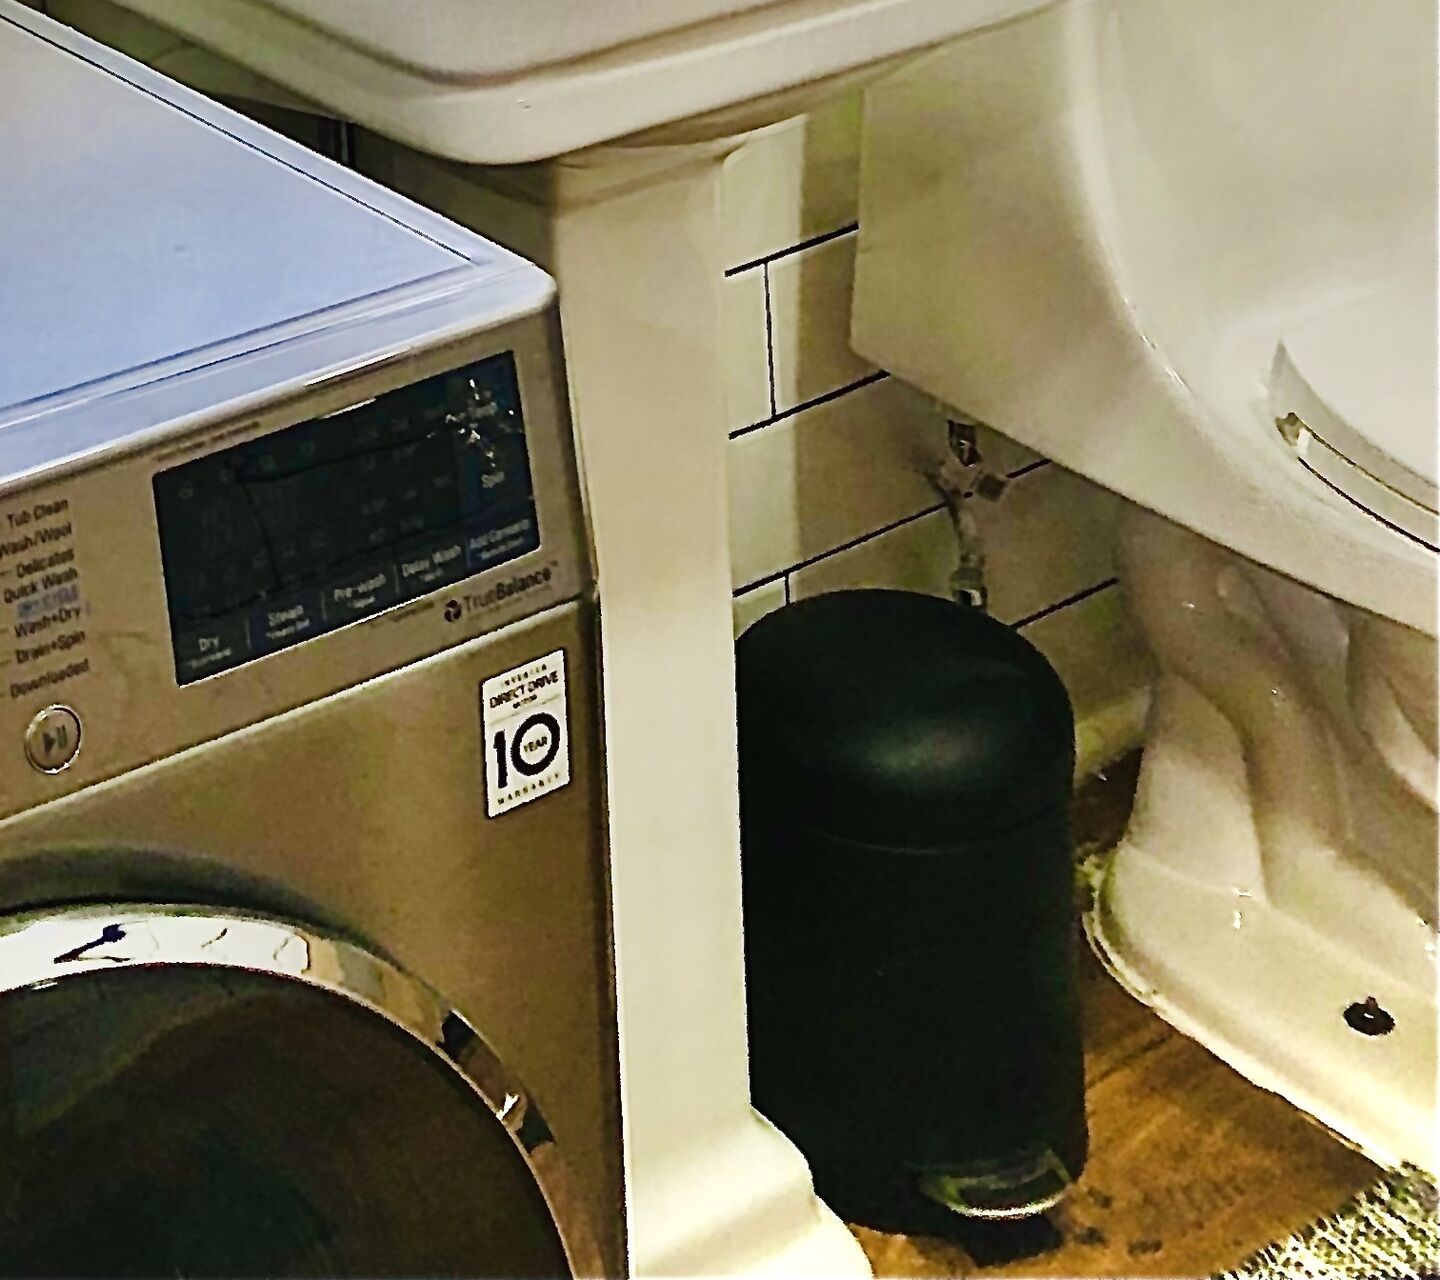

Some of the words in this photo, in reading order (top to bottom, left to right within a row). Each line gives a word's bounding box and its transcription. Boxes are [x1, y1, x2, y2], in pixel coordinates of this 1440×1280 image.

[7, 509, 31, 528] Tub
[33, 499, 69, 521] Clean
[16, 548, 75, 578] Delicates
[3, 581, 38, 604] Quick
[41, 567, 78, 590] Wash
[492, 711, 561, 790] 10
[522, 735, 549, 753] YEAR
